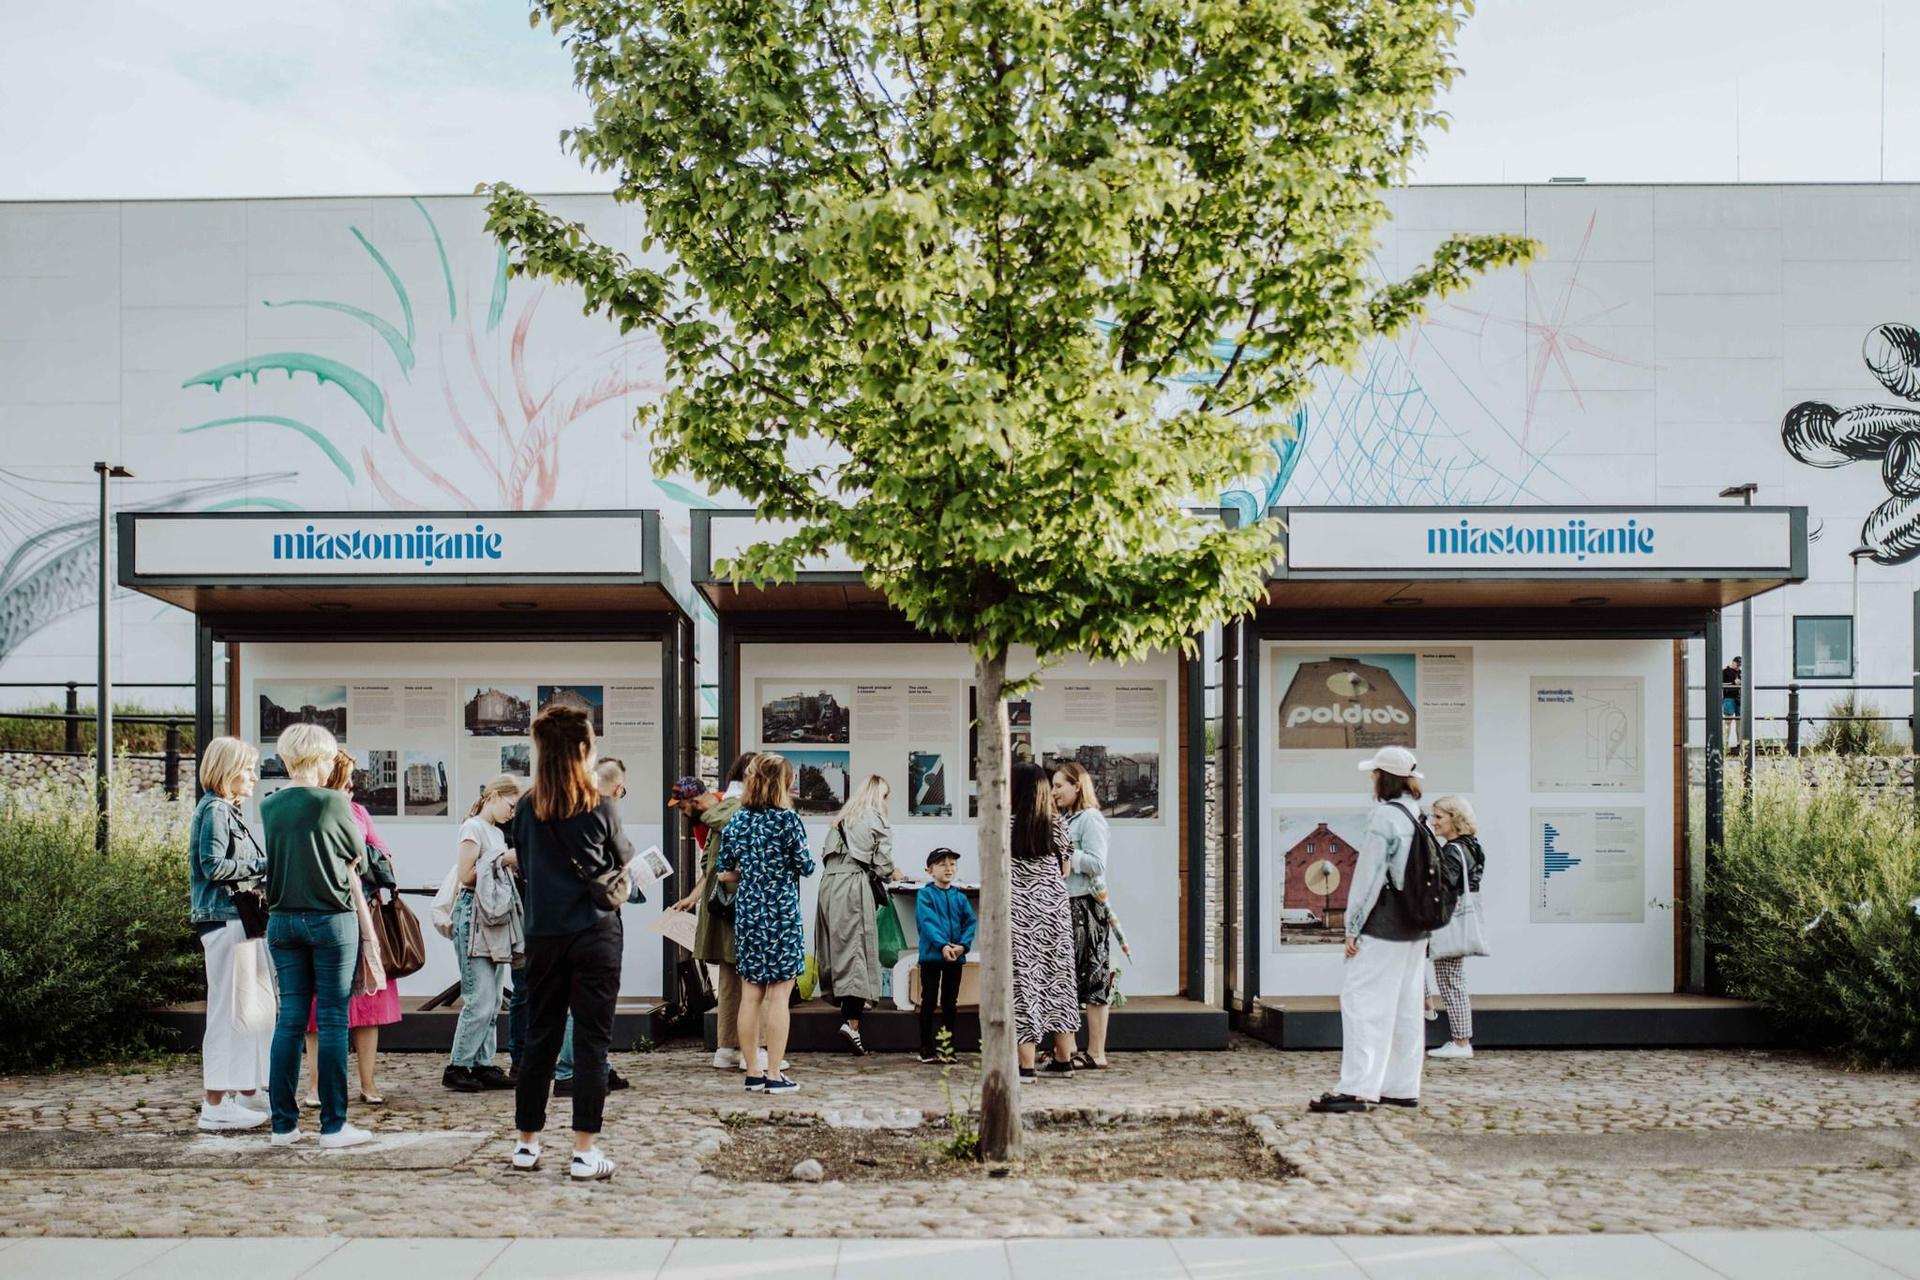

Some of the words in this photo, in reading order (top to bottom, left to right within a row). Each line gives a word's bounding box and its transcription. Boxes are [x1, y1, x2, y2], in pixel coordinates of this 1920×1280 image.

[273, 524, 503, 566] miastomijanie
[1427, 518, 1654, 561] miastomijanie
[1286, 704, 1410, 728] poldrob
